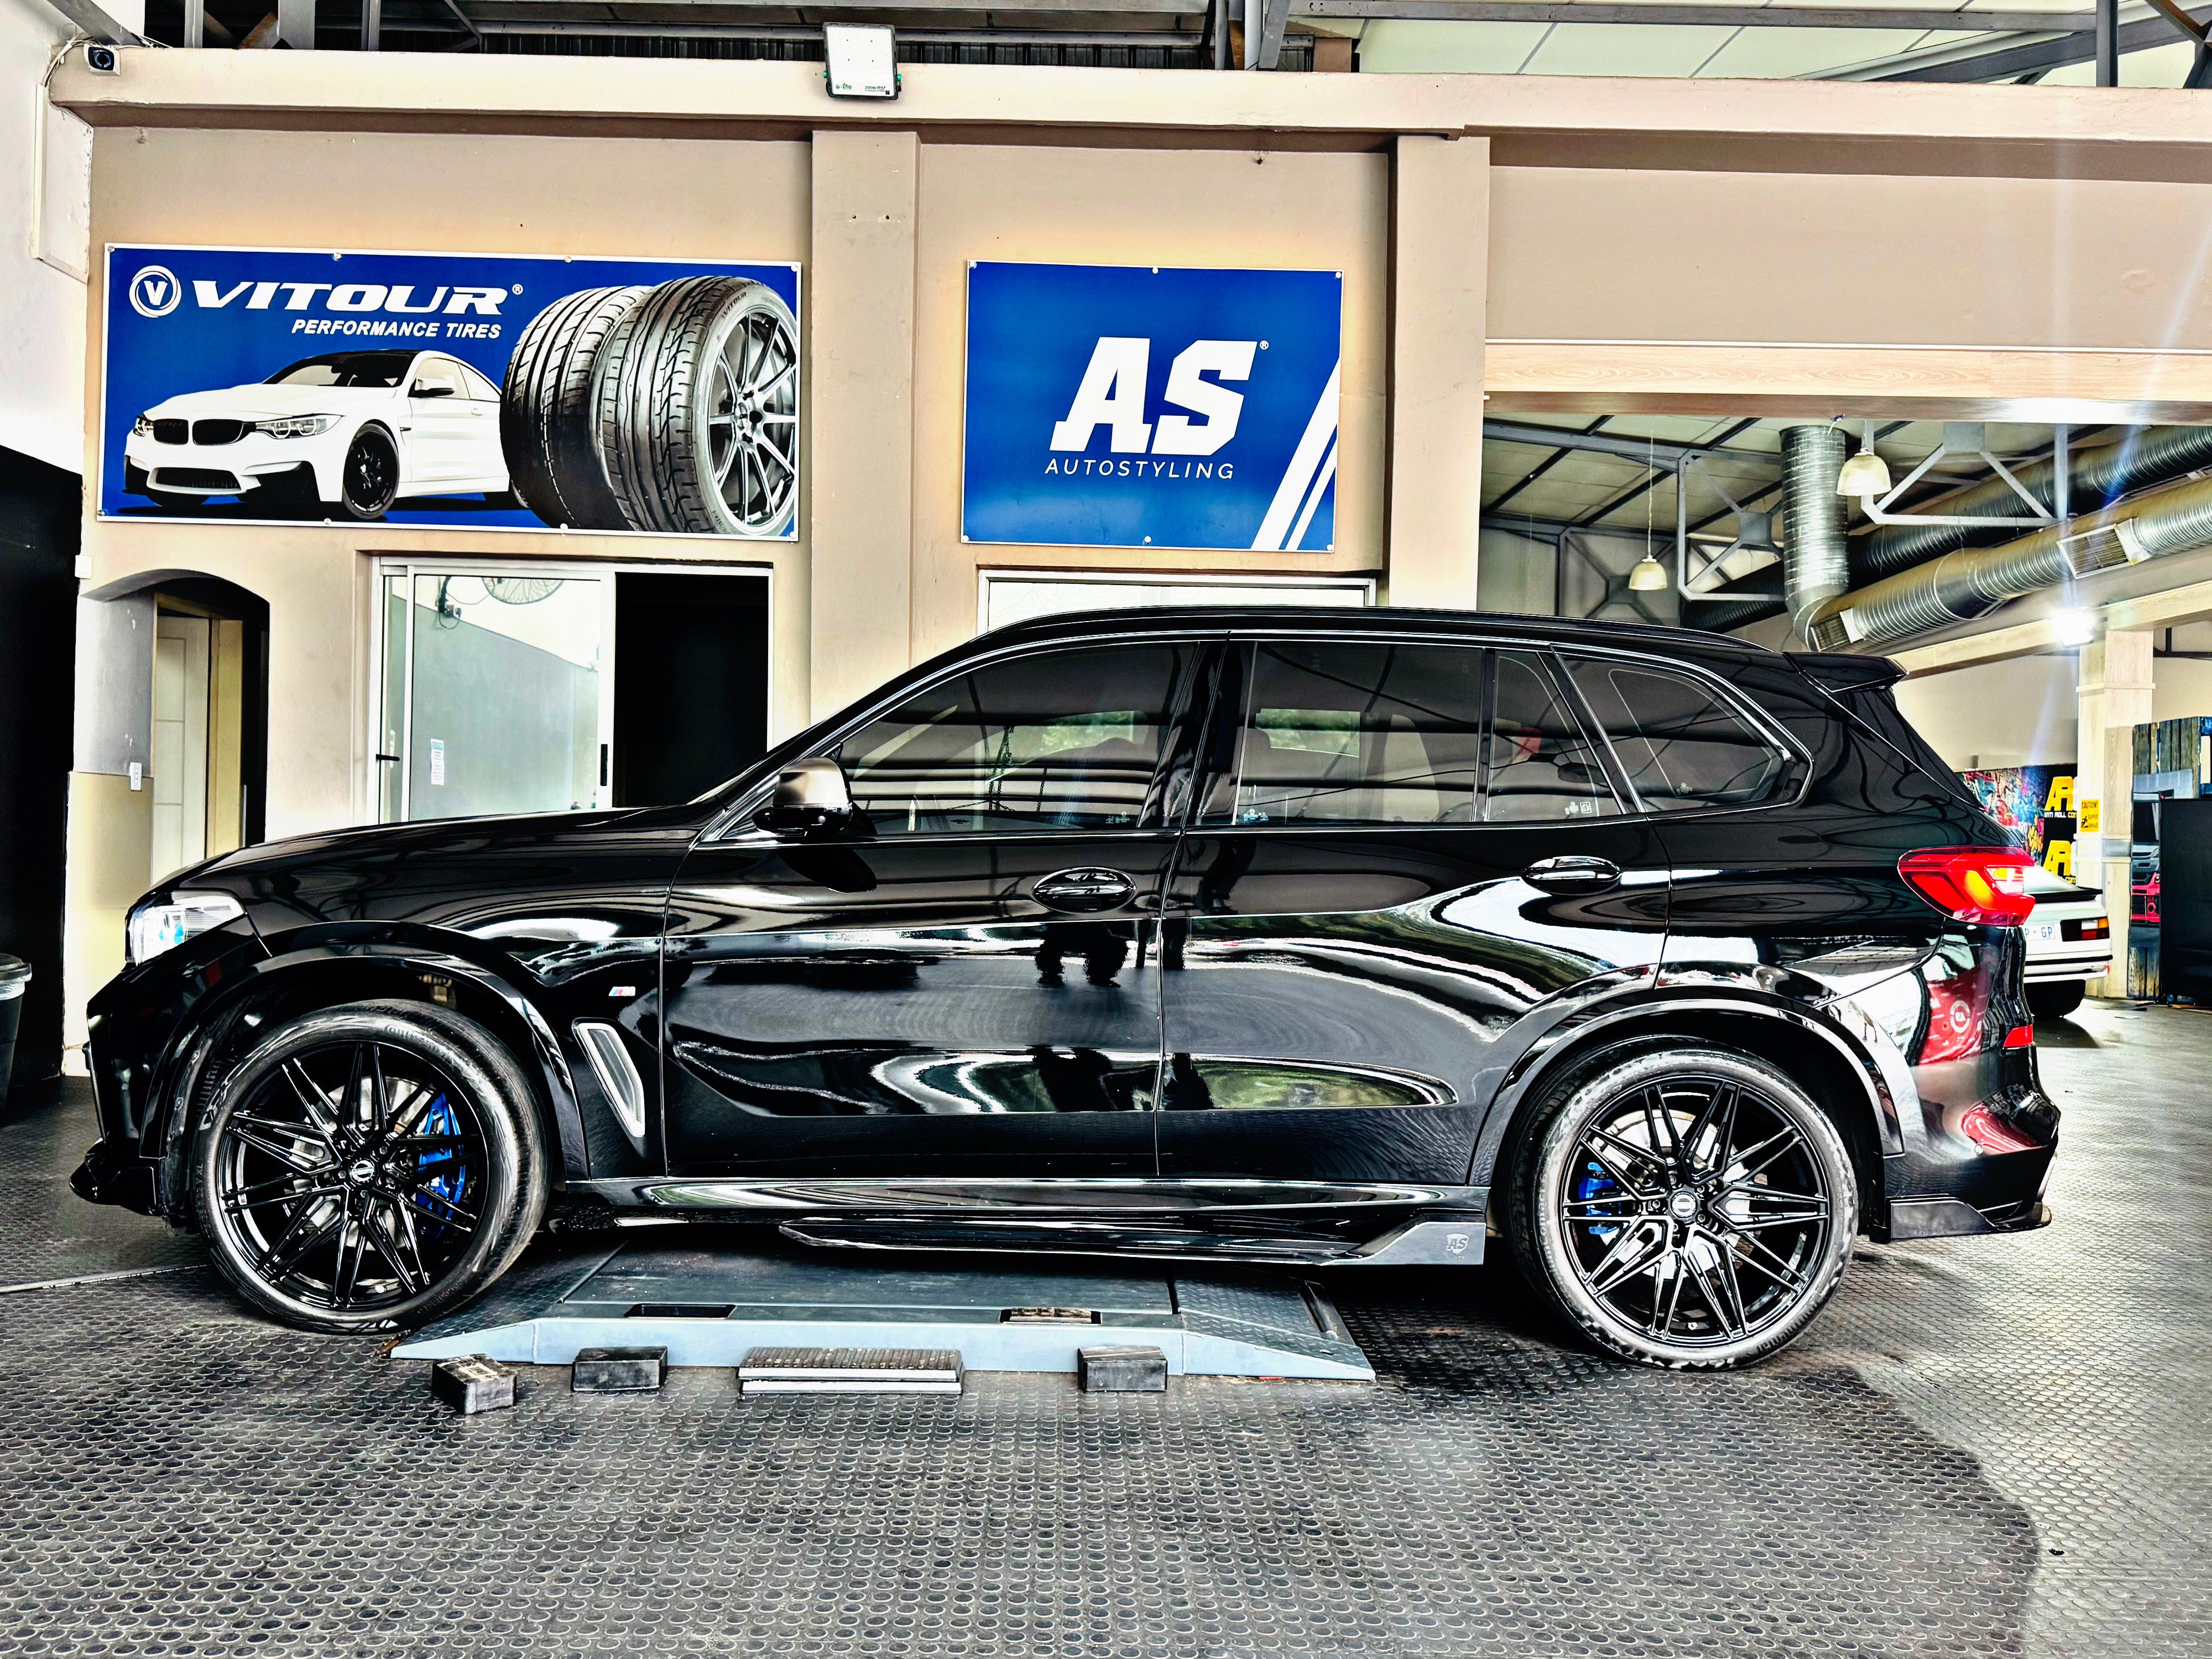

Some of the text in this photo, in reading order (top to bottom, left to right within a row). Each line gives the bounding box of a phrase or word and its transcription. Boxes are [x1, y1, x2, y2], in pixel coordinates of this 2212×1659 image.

[192, 280, 508, 315] VITOUR
[291, 319, 502, 339] PERFORMANCE TIRES
[1049, 337, 1258, 456] AS
[1045, 458, 1234, 479] AUTOSTYLING
[2041, 927, 2052, 938] GP
